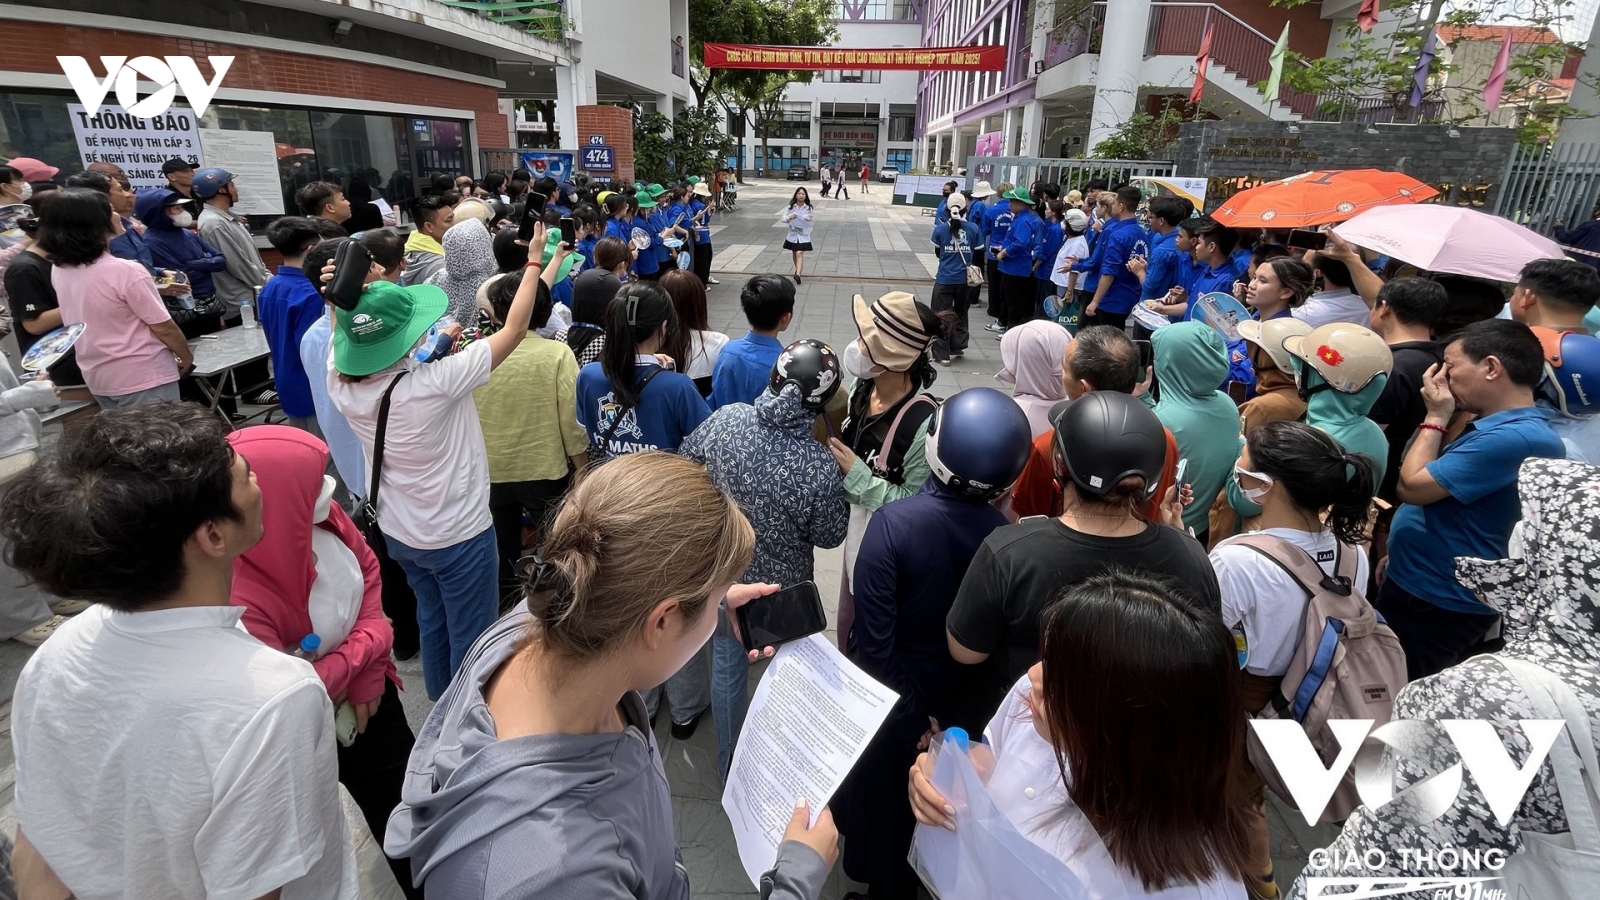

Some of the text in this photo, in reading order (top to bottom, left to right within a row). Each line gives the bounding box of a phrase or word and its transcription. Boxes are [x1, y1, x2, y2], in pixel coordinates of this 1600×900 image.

[727, 48, 741, 62] CHÚC
[742, 49, 752, 62] CÁC
[856, 53, 868, 64] CAO
[868, 53, 887, 64] TRONG
[895, 53, 905, 64] THI
[936, 53, 950, 64] THPT
[77, 109, 190, 131] THÔNG BÁO
[85, 133, 192, 150] ĐỂ PHỤC VỤ THI CẤP 3
[590, 136, 603, 144] 474
[127, 151, 141, 163] TỪ
[142, 151, 168, 163] NGÀY
[187, 154, 199, 164] 26
[586, 149, 609, 162] 474
[128, 167, 156, 179] SÁNG
[619, 421, 639, 432] ATHS
